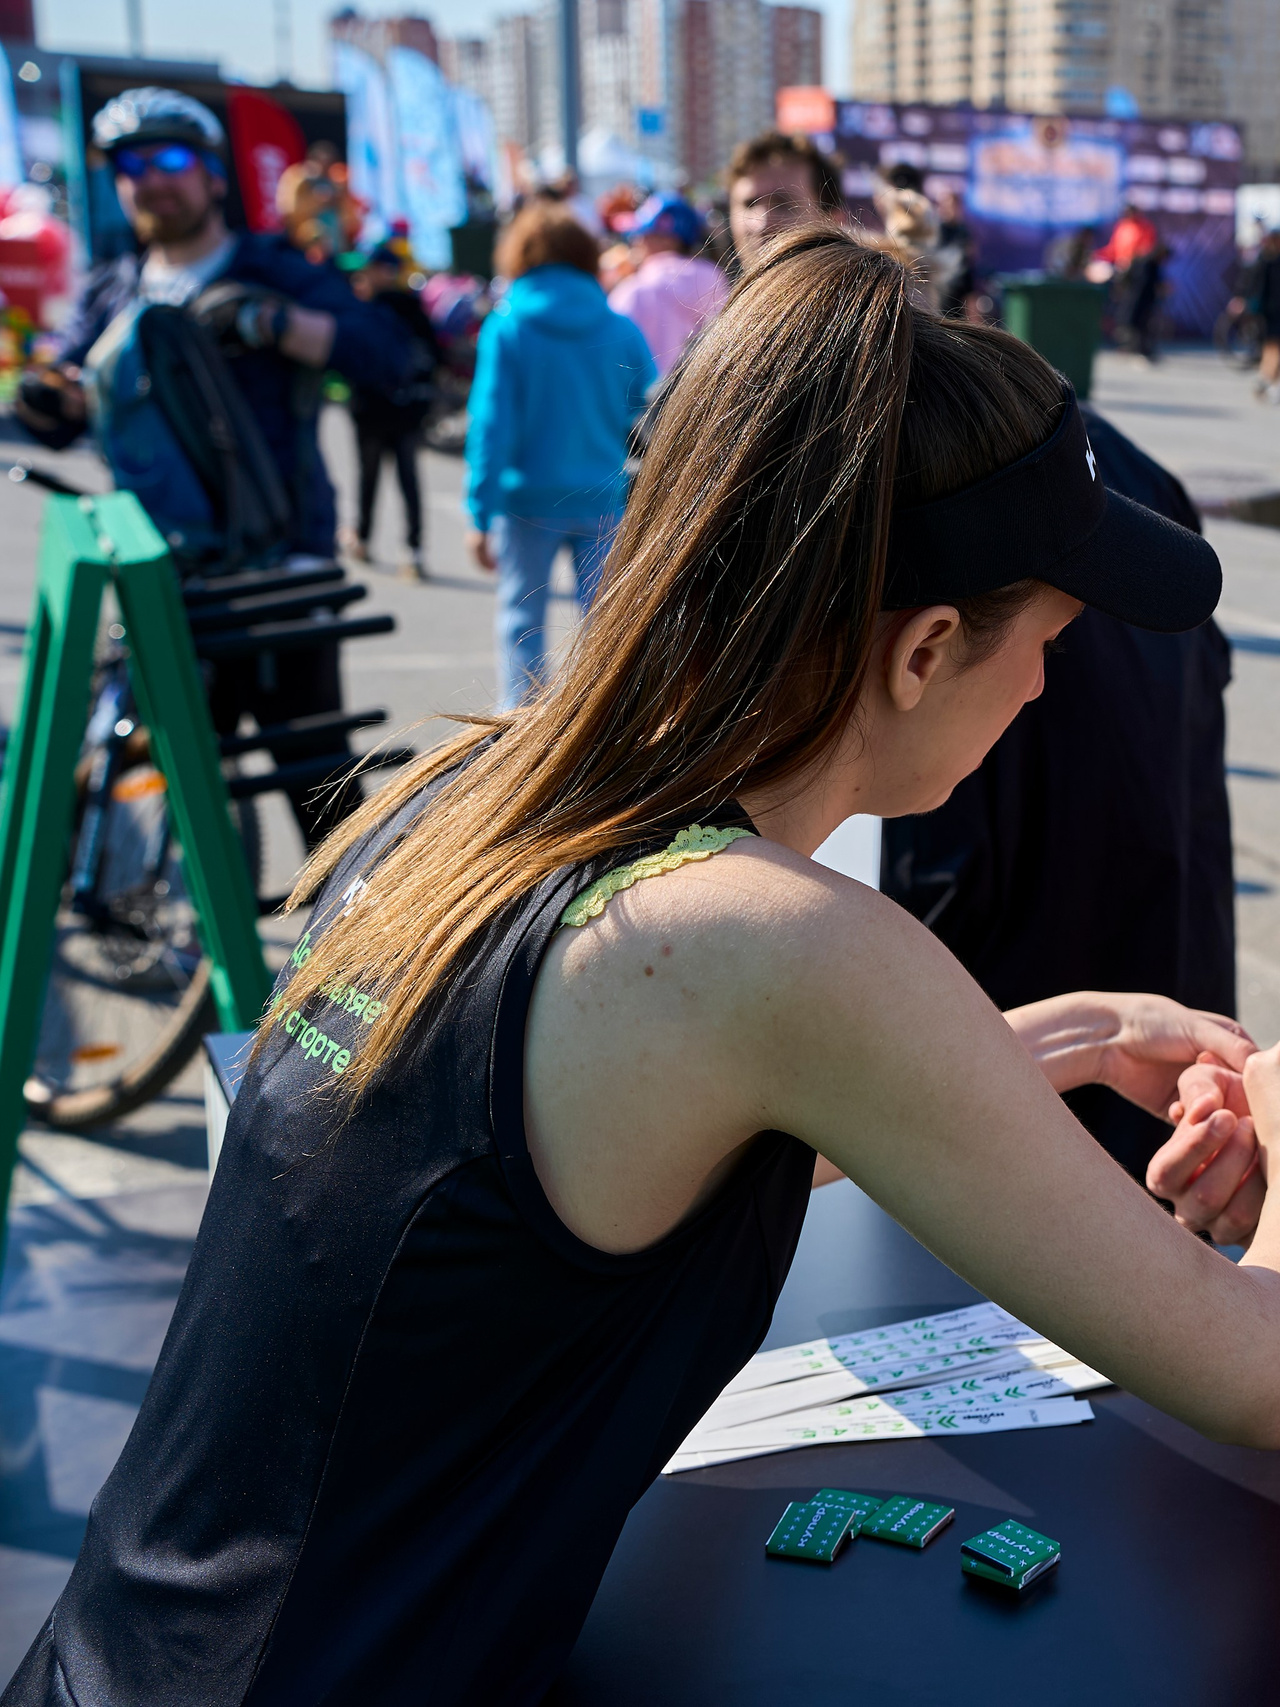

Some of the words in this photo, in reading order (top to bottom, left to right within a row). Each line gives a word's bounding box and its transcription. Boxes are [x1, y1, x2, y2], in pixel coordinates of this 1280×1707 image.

[285, 1010, 351, 1074] спорте
[798, 1507, 827, 1547] купер
[890, 1502, 925, 1532] купер
[986, 1530, 1036, 1556] купер
